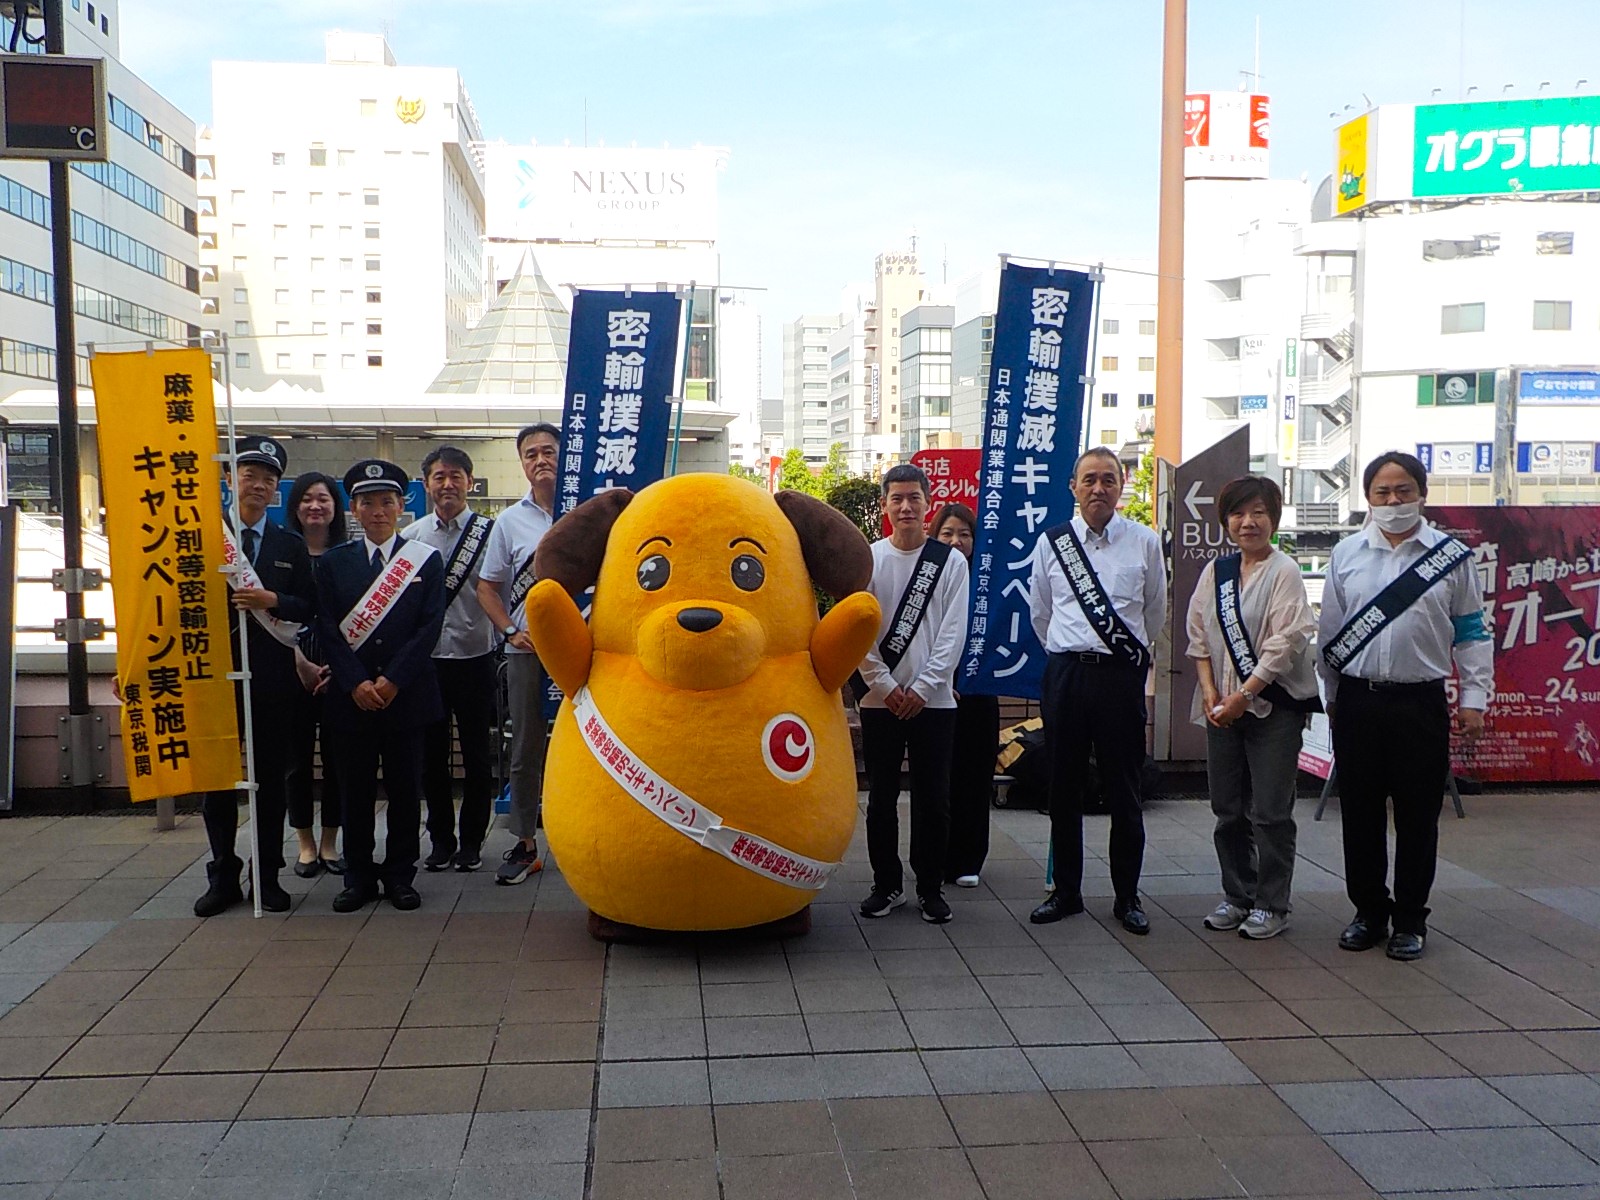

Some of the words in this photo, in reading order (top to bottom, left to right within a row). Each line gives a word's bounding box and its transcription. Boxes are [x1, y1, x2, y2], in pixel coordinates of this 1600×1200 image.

[572, 170, 686, 195] NEXUS
[597, 199, 661, 211] GROUP
[917, 457, 950, 476] お店
[992, 287, 1070, 678] 密輸撲滅キャンペーン
[445, 516, 490, 591] 東京通関業会
[1054, 533, 1143, 667] 密輸撲滅キャンペーン
[133, 446, 190, 771] キャンペーン実施中
[886, 560, 940, 655] 東京通関業会
[1219, 578, 1256, 677] 東京通関業会
[123, 683, 152, 777] 東京税関
[1545, 677, 1579, 703] 24
[584, 714, 697, 827] 麻薬等密輸防止キャンペーン
